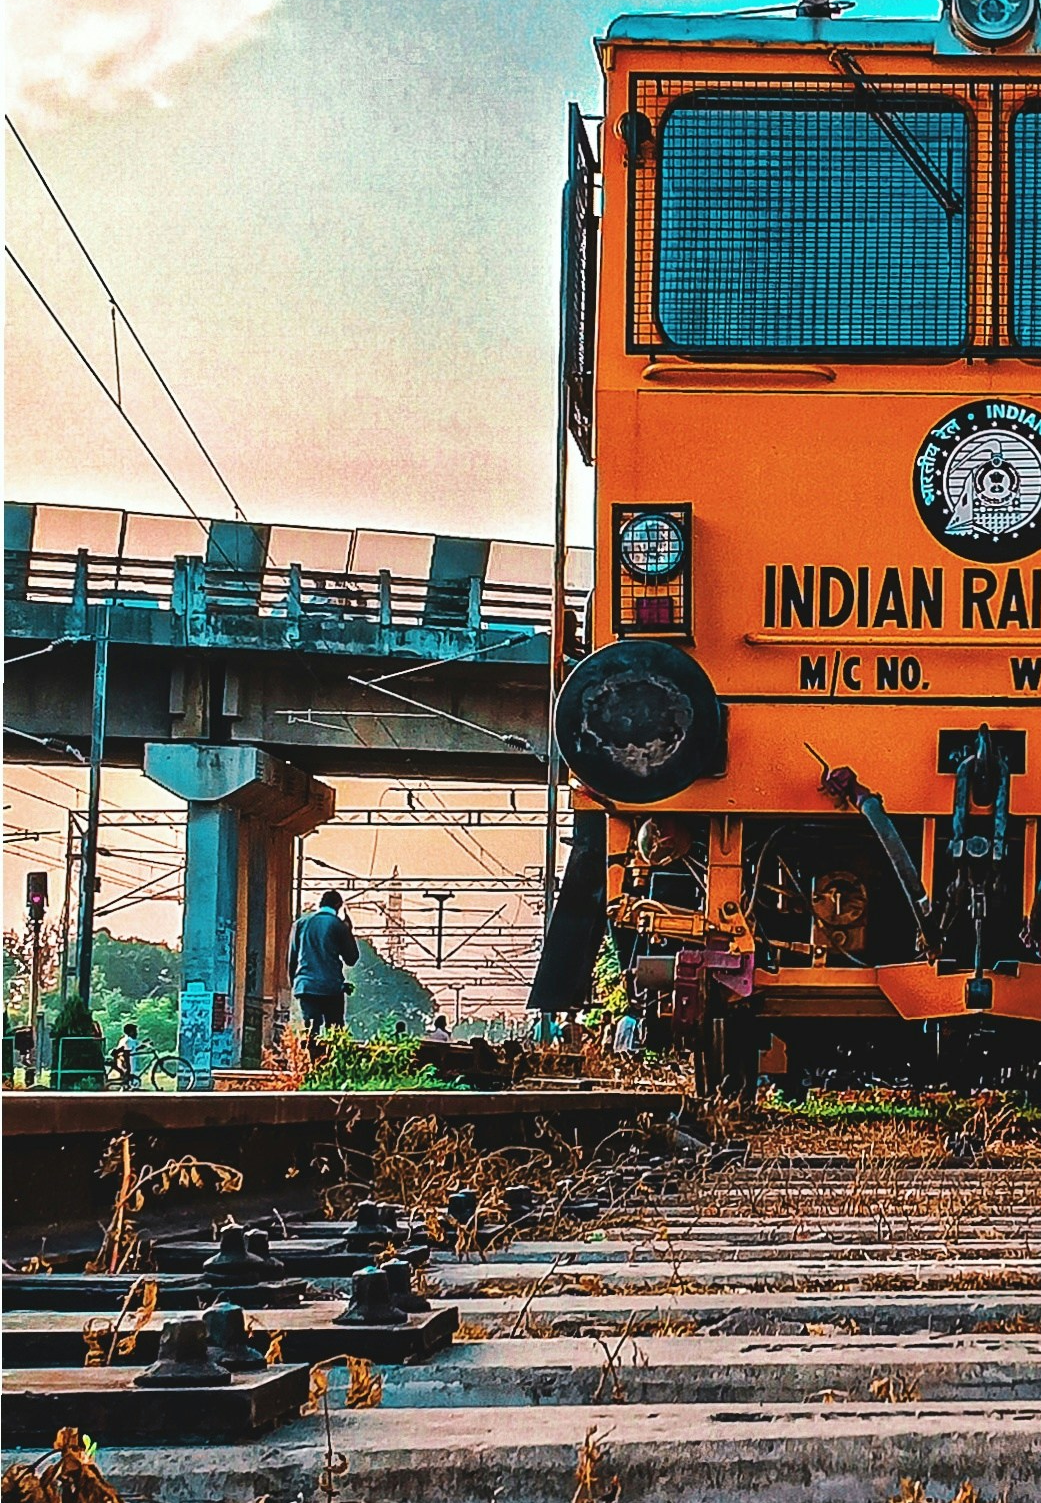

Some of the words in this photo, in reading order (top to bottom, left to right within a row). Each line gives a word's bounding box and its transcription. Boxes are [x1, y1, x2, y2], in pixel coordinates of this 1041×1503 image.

[917, 442, 940, 506] भारतीय
[930, 418, 961, 440] रेल
[765, 565, 942, 628] INDIAN
[801, 651, 860, 695] M/C
[877, 657, 928, 690] NO.
